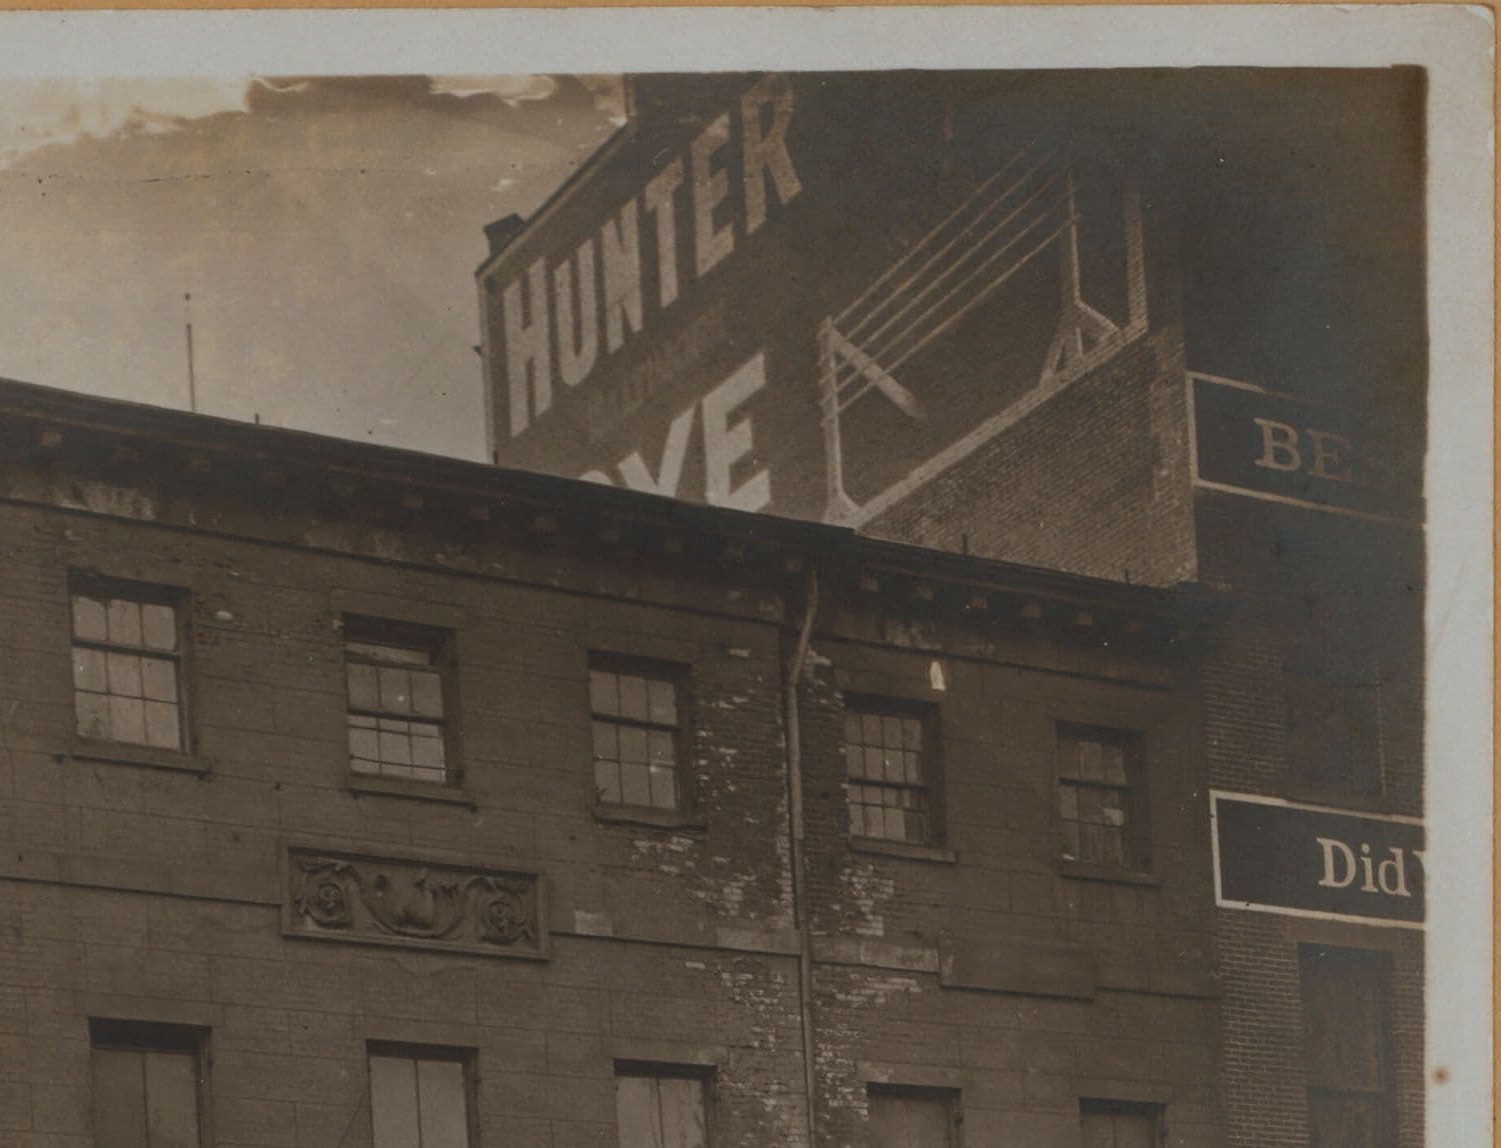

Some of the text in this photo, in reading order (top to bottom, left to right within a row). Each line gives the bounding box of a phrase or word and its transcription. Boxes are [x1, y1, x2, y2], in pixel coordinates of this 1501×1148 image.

[503, 78, 802, 437] HUNTER
[579, 352, 770, 512] YE
[1316, 837, 1412, 898] Did
